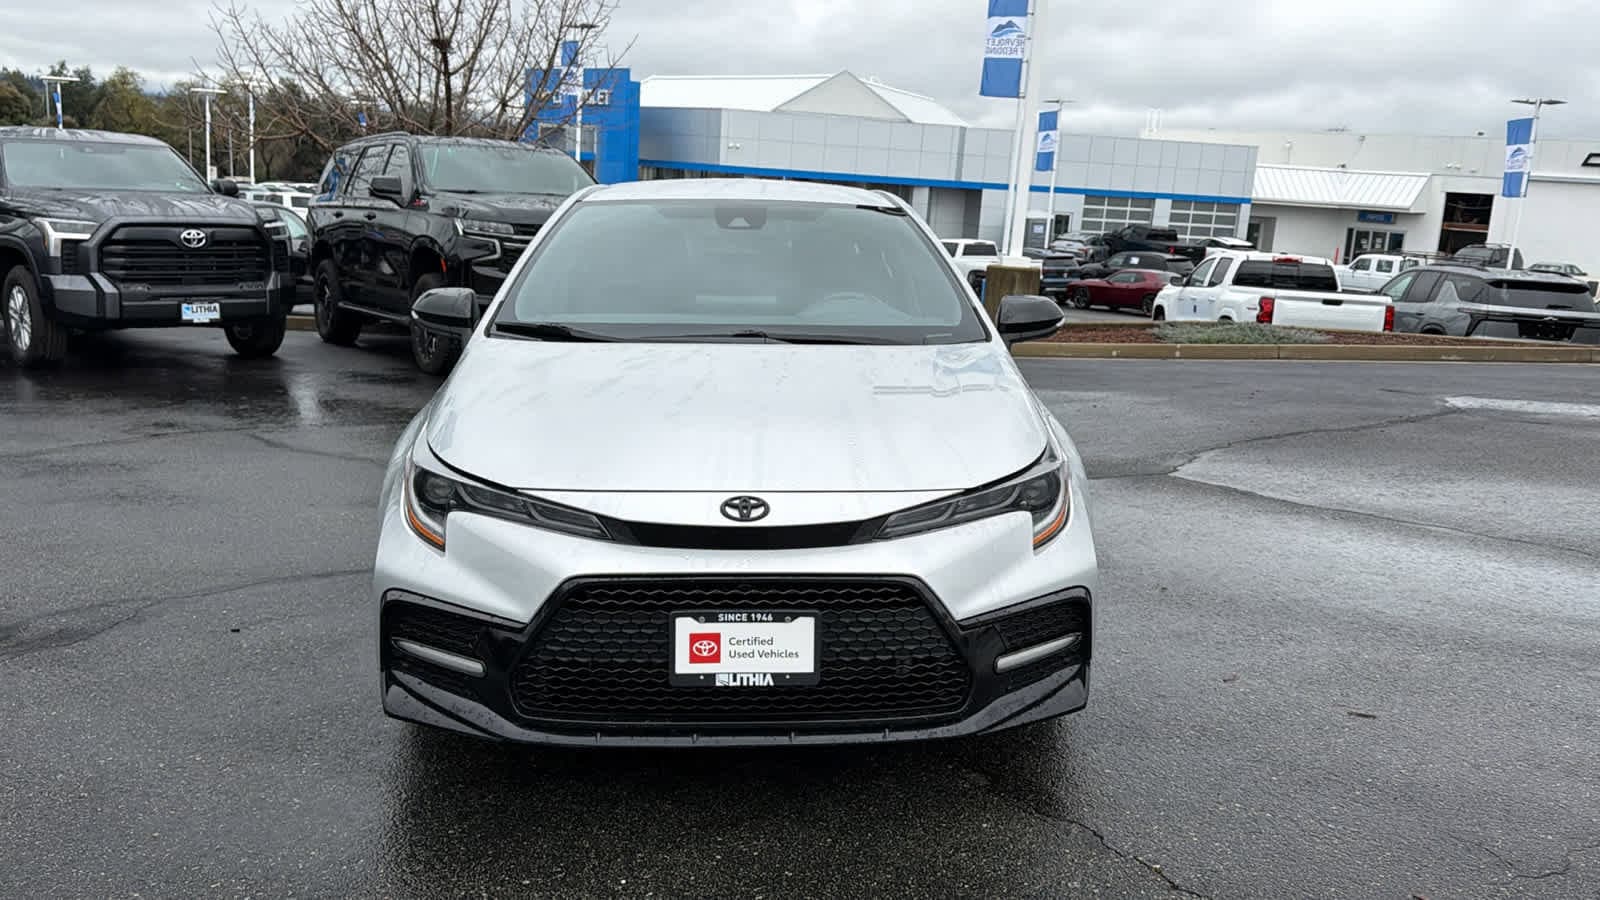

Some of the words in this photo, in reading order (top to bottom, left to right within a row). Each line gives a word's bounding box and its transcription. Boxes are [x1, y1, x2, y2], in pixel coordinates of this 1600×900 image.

[192, 305, 217, 313] LITHIA
[718, 613, 747, 621] SINCE
[751, 613, 773, 621] 1946
[728, 637, 774, 646] Certified
[728, 650, 755, 659] Used
[758, 649, 799, 659] Vehicles
[729, 673, 774, 686] LITHIA
